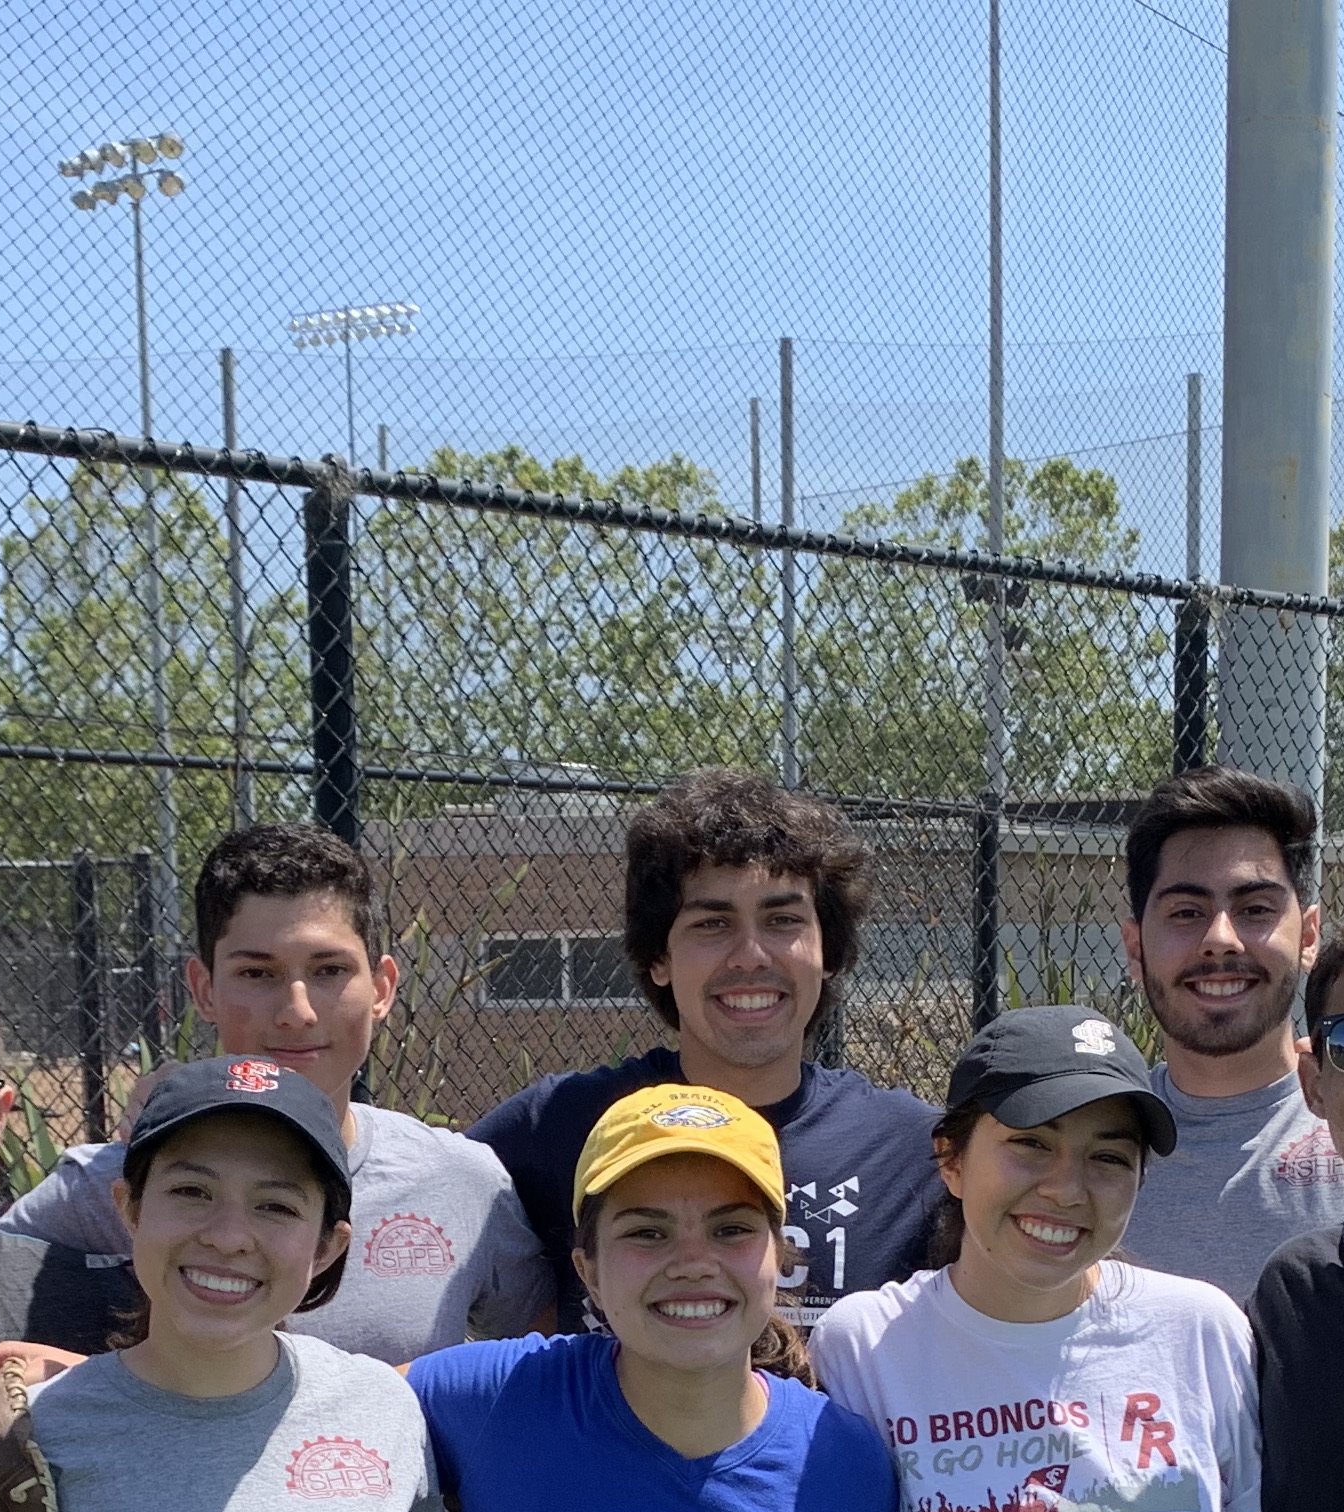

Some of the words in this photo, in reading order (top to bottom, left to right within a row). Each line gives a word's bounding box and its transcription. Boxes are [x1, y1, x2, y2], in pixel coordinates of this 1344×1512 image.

[382, 1248, 441, 1268] SHPE
[929, 1398, 1090, 1443] BRONCOS
[932, 1444, 984, 1476] GO
[996, 1431, 1092, 1468] HOME
[307, 1467, 383, 1491] SHPE
